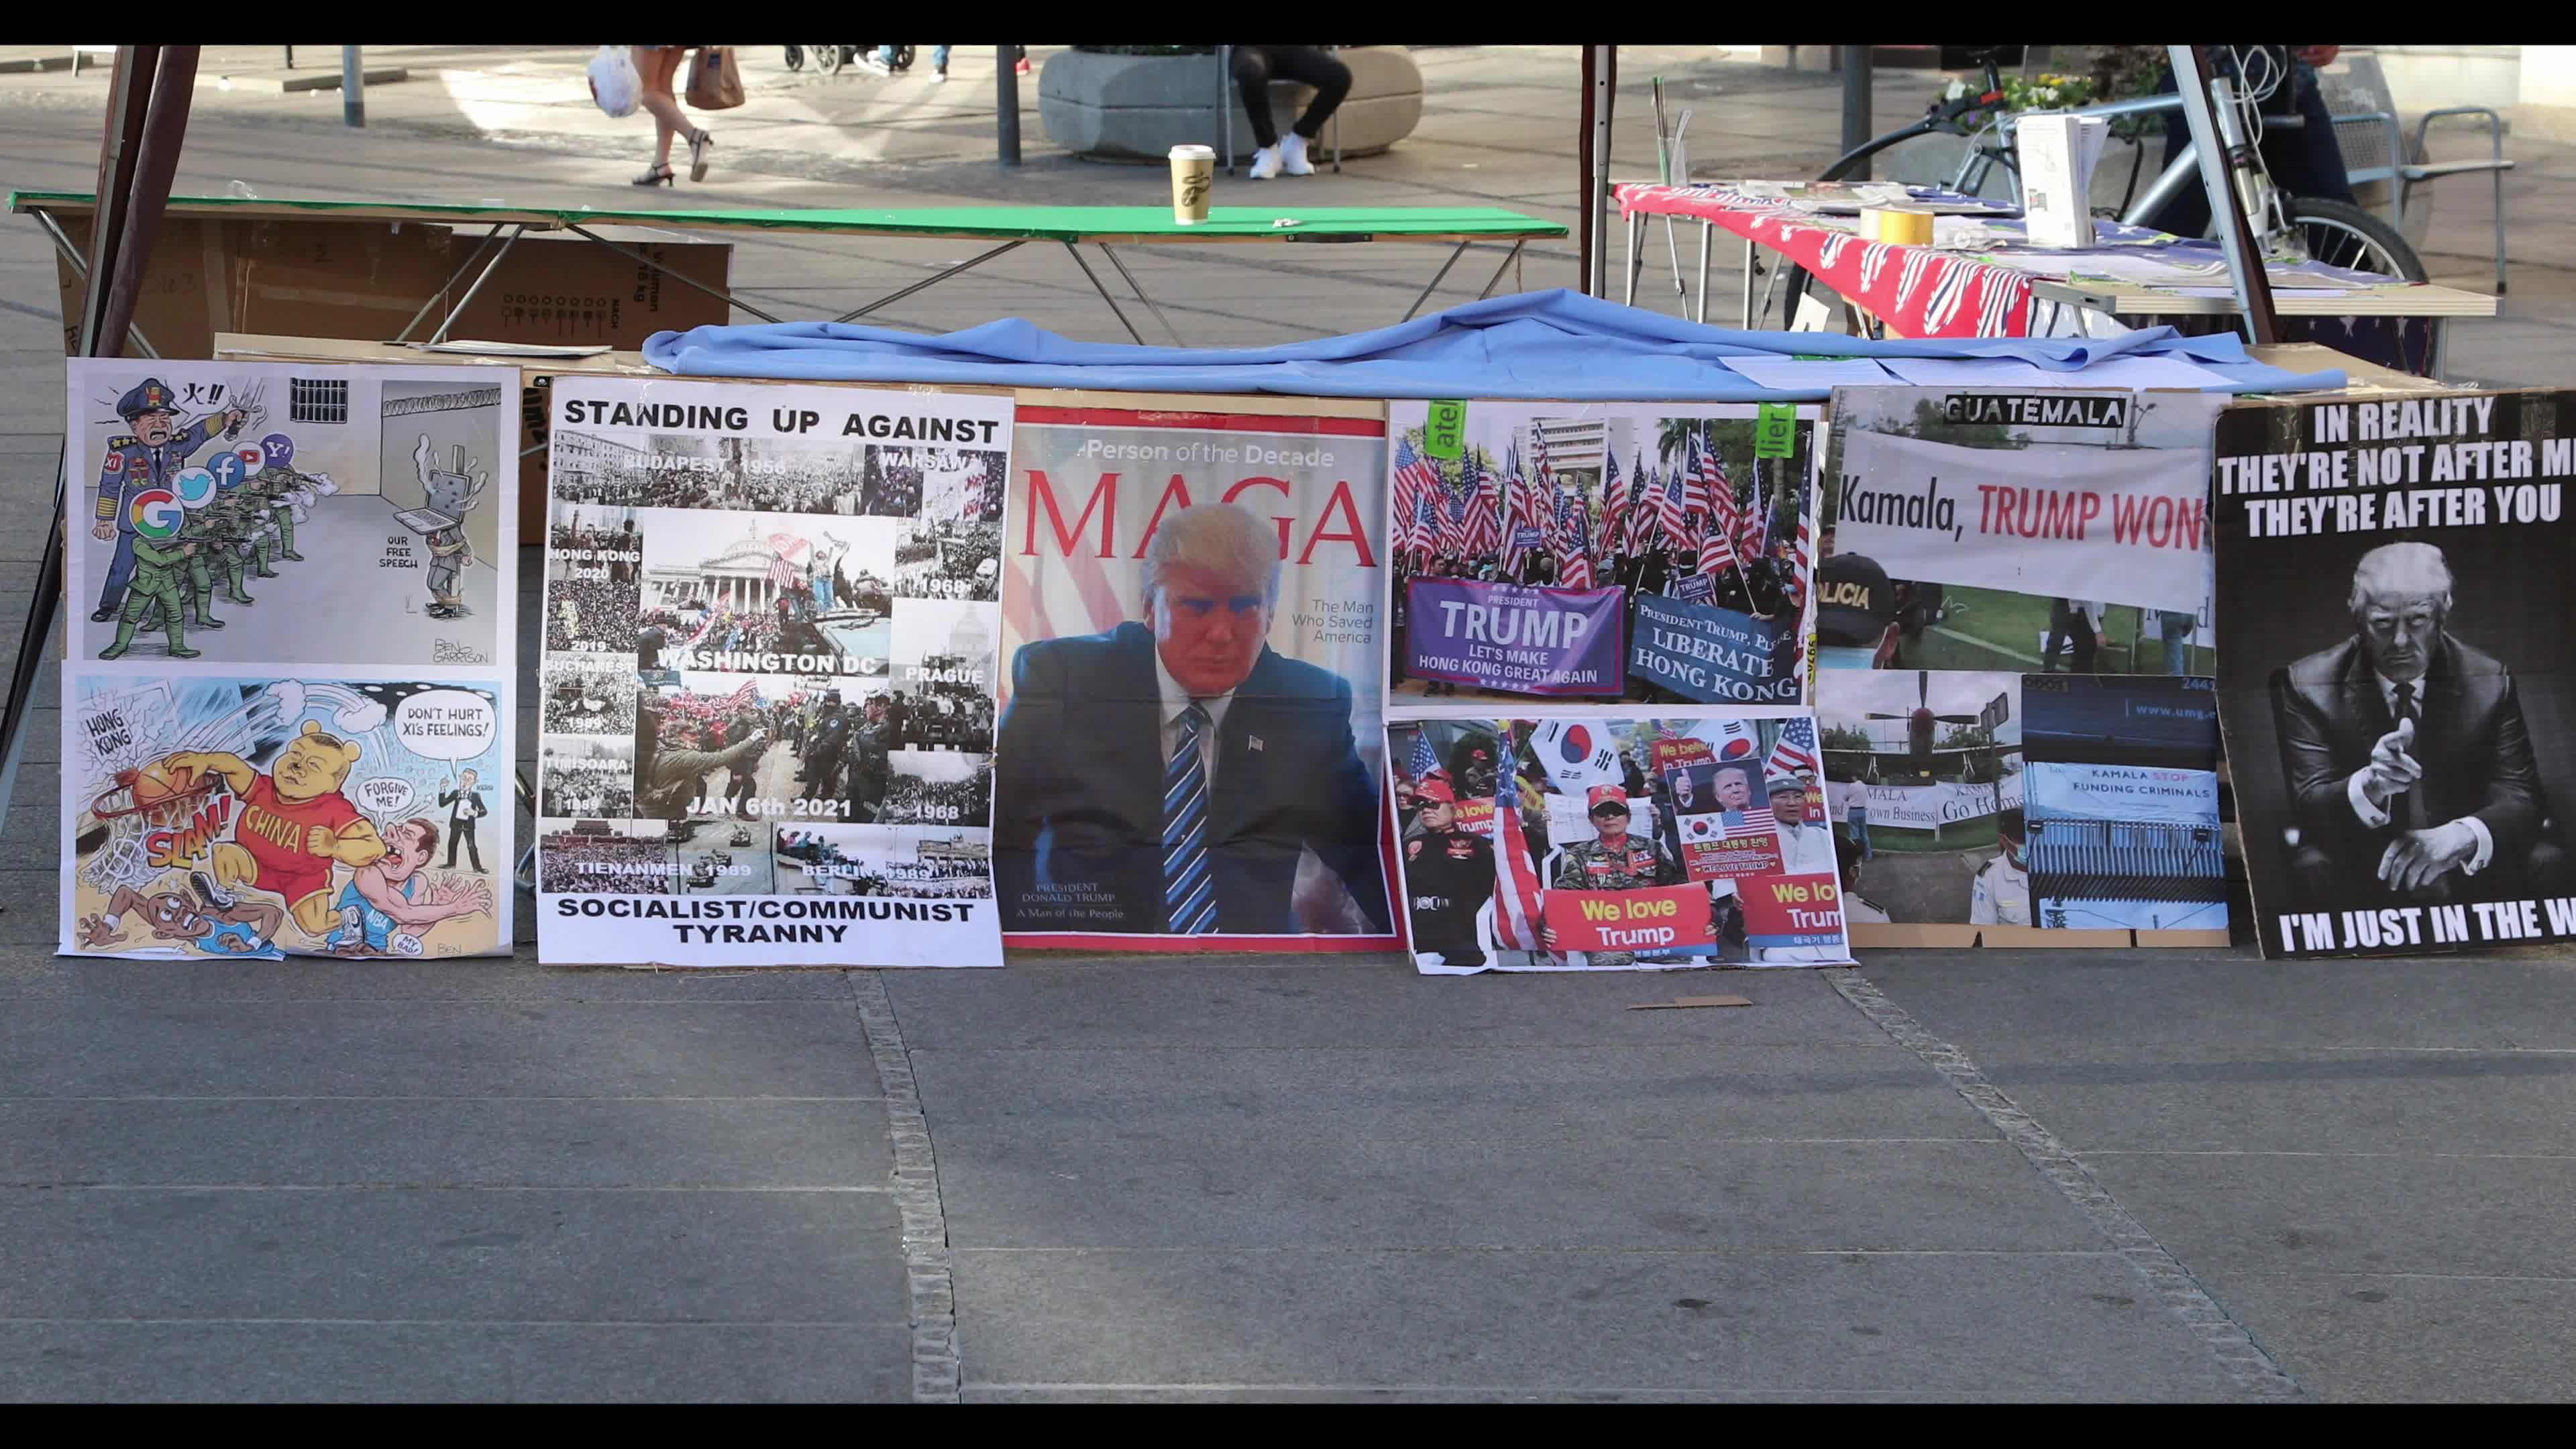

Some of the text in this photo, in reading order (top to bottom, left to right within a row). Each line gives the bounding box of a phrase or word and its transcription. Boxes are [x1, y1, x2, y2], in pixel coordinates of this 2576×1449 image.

[1946, 397, 2123, 427] GUATEMALA
[2314, 396, 2496, 443] IN REALITY
[564, 400, 999, 443] STANDING UP AGAINST
[879, 451, 969, 472] WARSAW
[1087, 439, 1335, 468] Person of the Decade
[623, 454, 727, 473] BUDAPEST
[2217, 437, 2576, 495] THEY'RE NOT AFTER M
[1839, 475, 2203, 551] Kamala, TRUMP WON
[2244, 483, 2561, 537] THEY'RE AFTER YOU
[1019, 469, 1379, 568] MAGA
[387, 536, 409, 545] OUR
[386, 547, 411, 557] FREE
[550, 549, 641, 562] HONG KONG
[379, 558, 418, 568] SPEECH
[574, 568, 609, 579] 2020
[922, 579, 966, 594] 1968
[1679, 578, 1708, 592] TRUMP
[1312, 599, 1374, 614] The Man
[1487, 595, 1540, 608] PRESIDENT
[1292, 614, 1373, 629] Who Saved
[1440, 600, 1590, 649] TRUMP
[1313, 630, 1372, 644] America
[571, 641, 607, 651] 2019
[1652, 627, 1774, 678] LIBERATE
[433, 652, 489, 663] GARRISON
[656, 649, 878, 674] WASHINGTON DC
[1468, 644, 1549, 665] LET'S MAKE
[905, 666, 984, 684] PRAGUE
[1419, 655, 1598, 684] HONG KONG GREAT AGAIN
[1635, 648, 1798, 702] HONG KONG
[408, 708, 483, 720] DON'T HURT
[86, 708, 124, 737] HONG
[427, 722, 489, 737] FEELINGS!
[568, 717, 602, 729] 1989
[95, 729, 132, 756] KONG
[1659, 743, 1676, 757] We
[544, 757, 629, 773] TIMISOARA
[2092, 769, 2189, 782] KAMALA STOP
[364, 782, 409, 798] FORGIVE
[2073, 782, 2210, 798] FUNDING CRIMINALS
[376, 796, 400, 808] ME!
[686, 796, 851, 817] JAN 6th 2021
[916, 805, 959, 820] 1968
[1466, 804, 1493, 819] love
[1809, 806, 1821, 818] In
[1870, 808, 1890, 819] own
[1892, 806, 1936, 822] Business
[1943, 800, 1970, 821] Go
[146, 794, 231, 870] SLAM!
[246, 805, 301, 854] CHINA
[1456, 819, 1495, 833] Trump
[575, 863, 752, 877] TIENANMEN 1989
[1739, 861, 1768, 871] TRUMP
[1036, 883, 1099, 892] PRESIDENT
[1771, 883, 1809, 903] We
[1022, 894, 1116, 902] DONALD TRUMP
[557, 899, 974, 922] SOCIALIST/COMMUNIST
[1089, 909, 1124, 920] People
[1580, 899, 1677, 921] We love
[367, 908, 389, 930] NBA
[2279, 912, 2335, 953] I'M
[2342, 907, 2422, 949] JUST
[2428, 904, 2469, 943] IN
[2472, 900, 2541, 940] THE
[402, 936, 418, 947] MY
[673, 924, 848, 943] TYRANNY
[1595, 926, 1675, 946] Trump
[397, 942, 419, 953] BAD!
